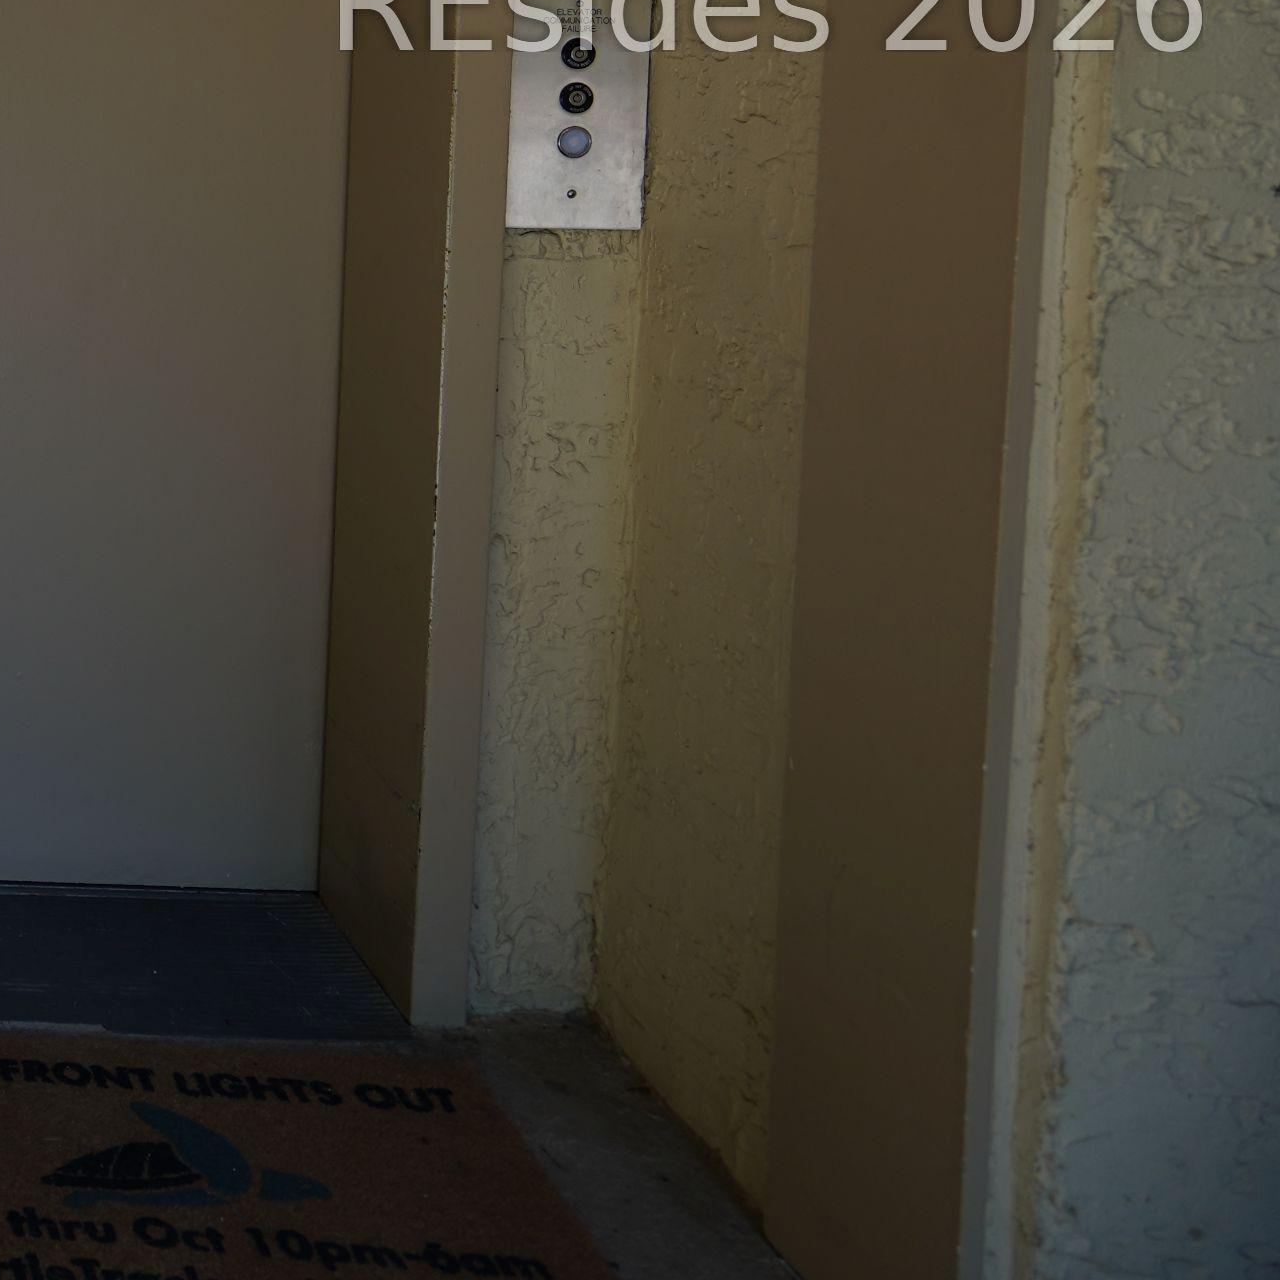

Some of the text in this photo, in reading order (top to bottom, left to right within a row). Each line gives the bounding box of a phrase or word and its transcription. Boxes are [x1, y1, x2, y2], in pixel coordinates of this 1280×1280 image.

[556, 8, 602, 16] ELEVATOR
[173, 1071, 344, 1108] LIGHTS
[353, 1081, 458, 1115] OUT
[6, 1205, 116, 1244] thru
[132, 1216, 227, 1254] Oct
